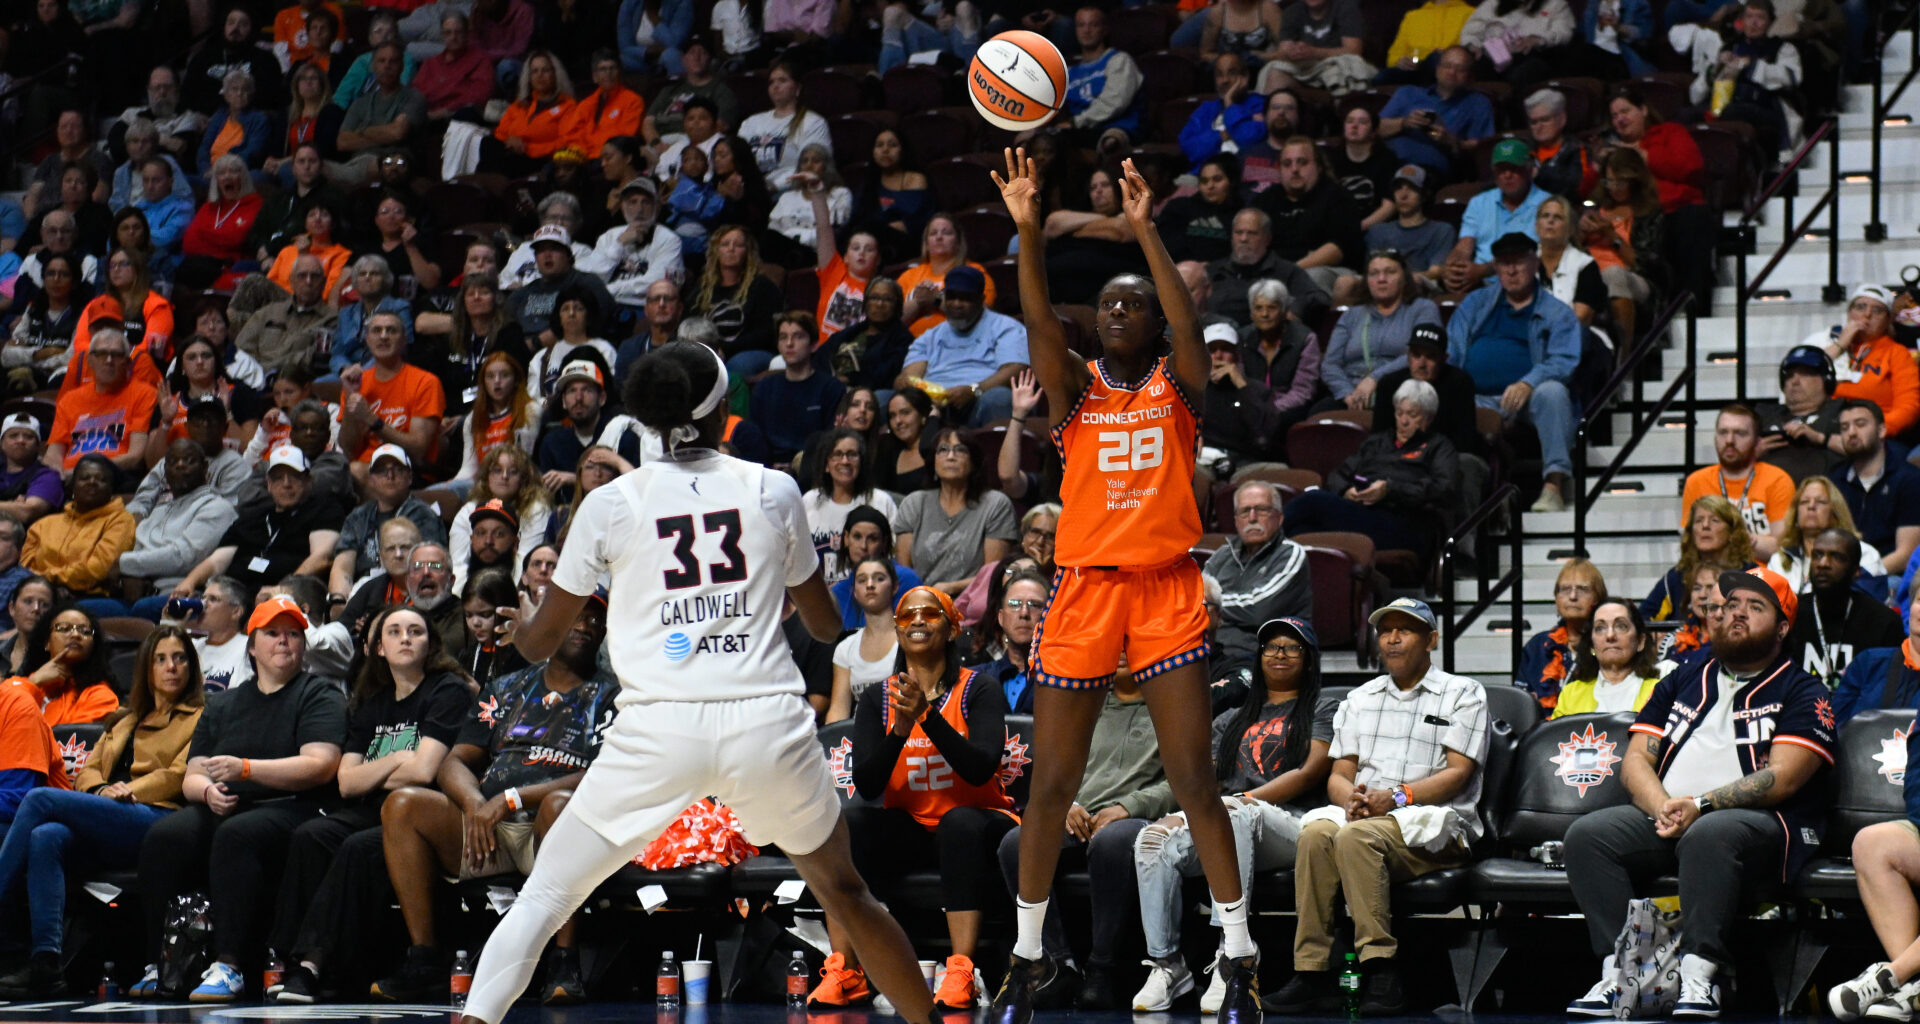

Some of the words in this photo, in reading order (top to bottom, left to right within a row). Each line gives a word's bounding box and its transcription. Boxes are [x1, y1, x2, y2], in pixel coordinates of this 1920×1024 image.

[974, 69, 1025, 117] Wilson
[1081, 404, 1173, 425] CONNECTICUT
[1097, 426, 1164, 472] 28
[1106, 478, 1126, 489] Yale
[1106, 498, 1141, 511] Health
[656, 508, 748, 591] 33
[660, 590, 752, 626] CALDWELL
[695, 633, 750, 655] AT&T
[905, 754, 955, 792] 22
